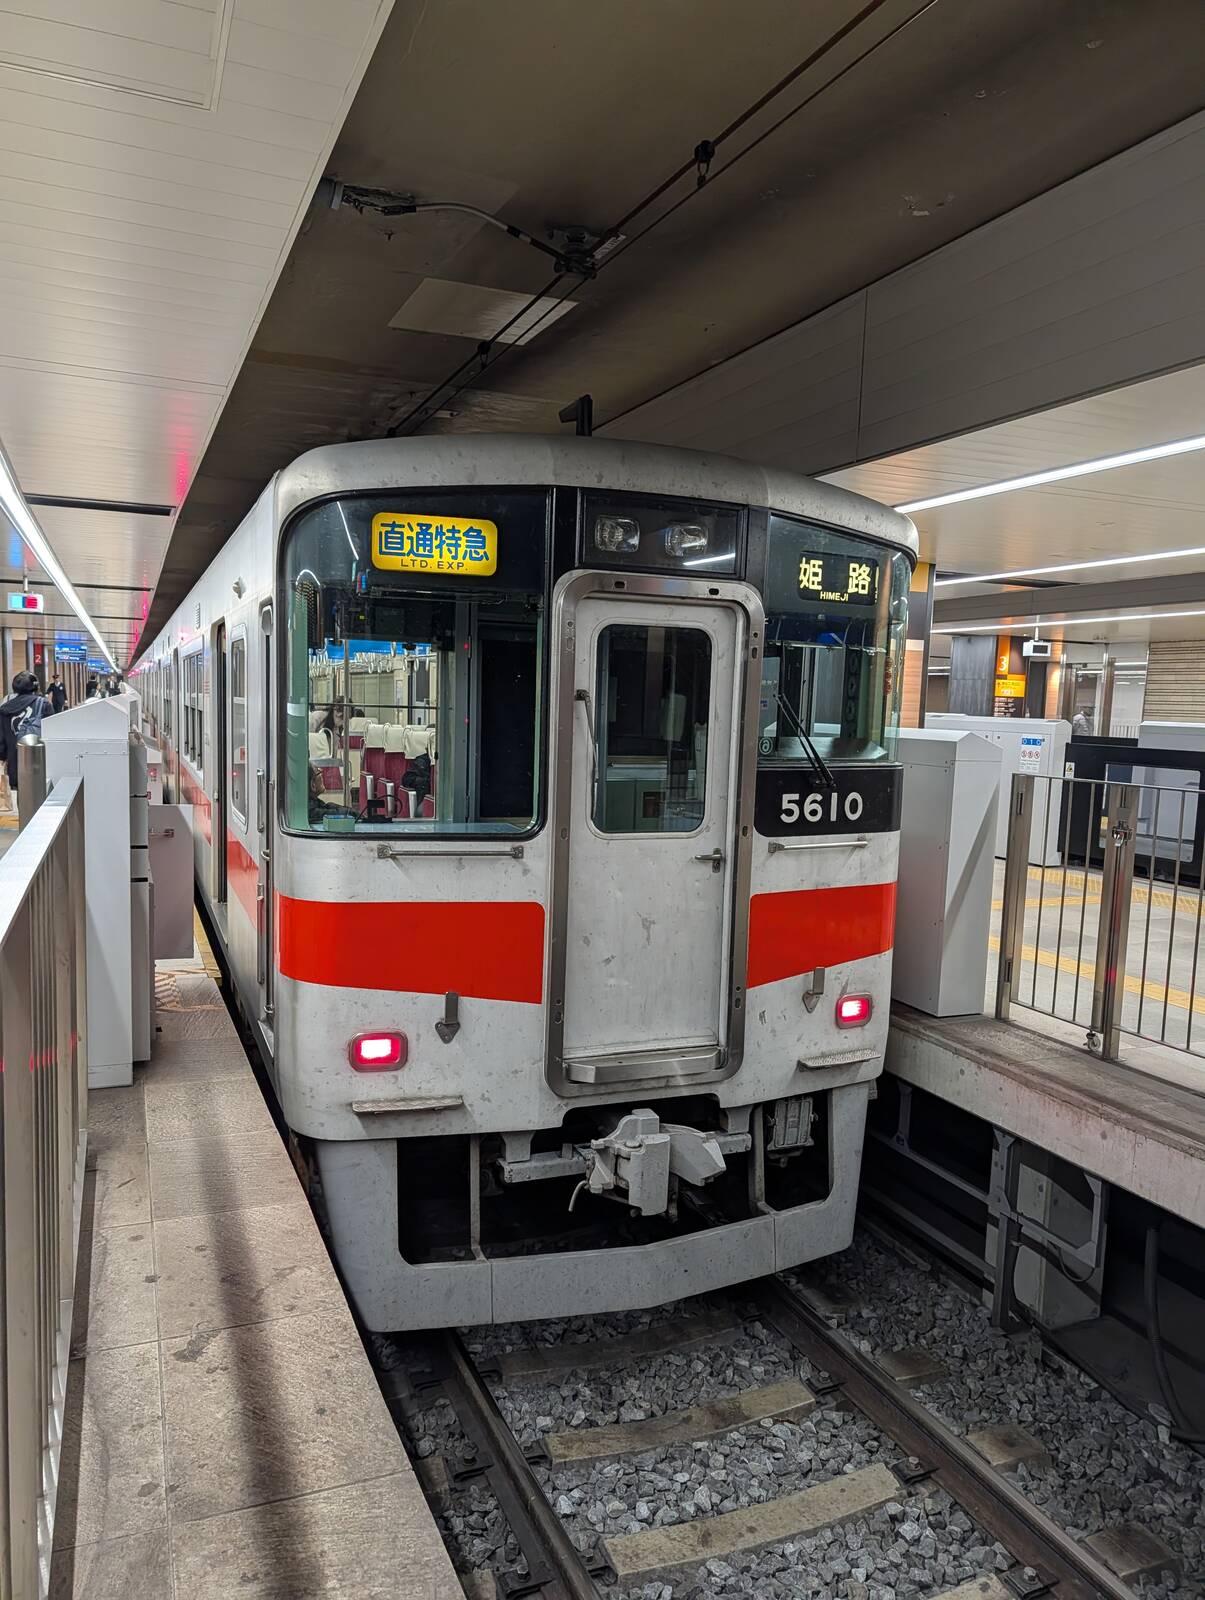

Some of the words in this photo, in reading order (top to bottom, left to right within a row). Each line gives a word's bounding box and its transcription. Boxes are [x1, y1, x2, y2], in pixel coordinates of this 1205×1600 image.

[379, 521, 490, 562] 直通特急
[400, 558, 433, 569] LTD.
[437, 560, 468, 571] EXP.
[820, 591, 849, 602] HIMEJI
[35, 654, 41, 663] 2
[999, 656, 1008, 671] 3
[780, 792, 863, 823] 5610
